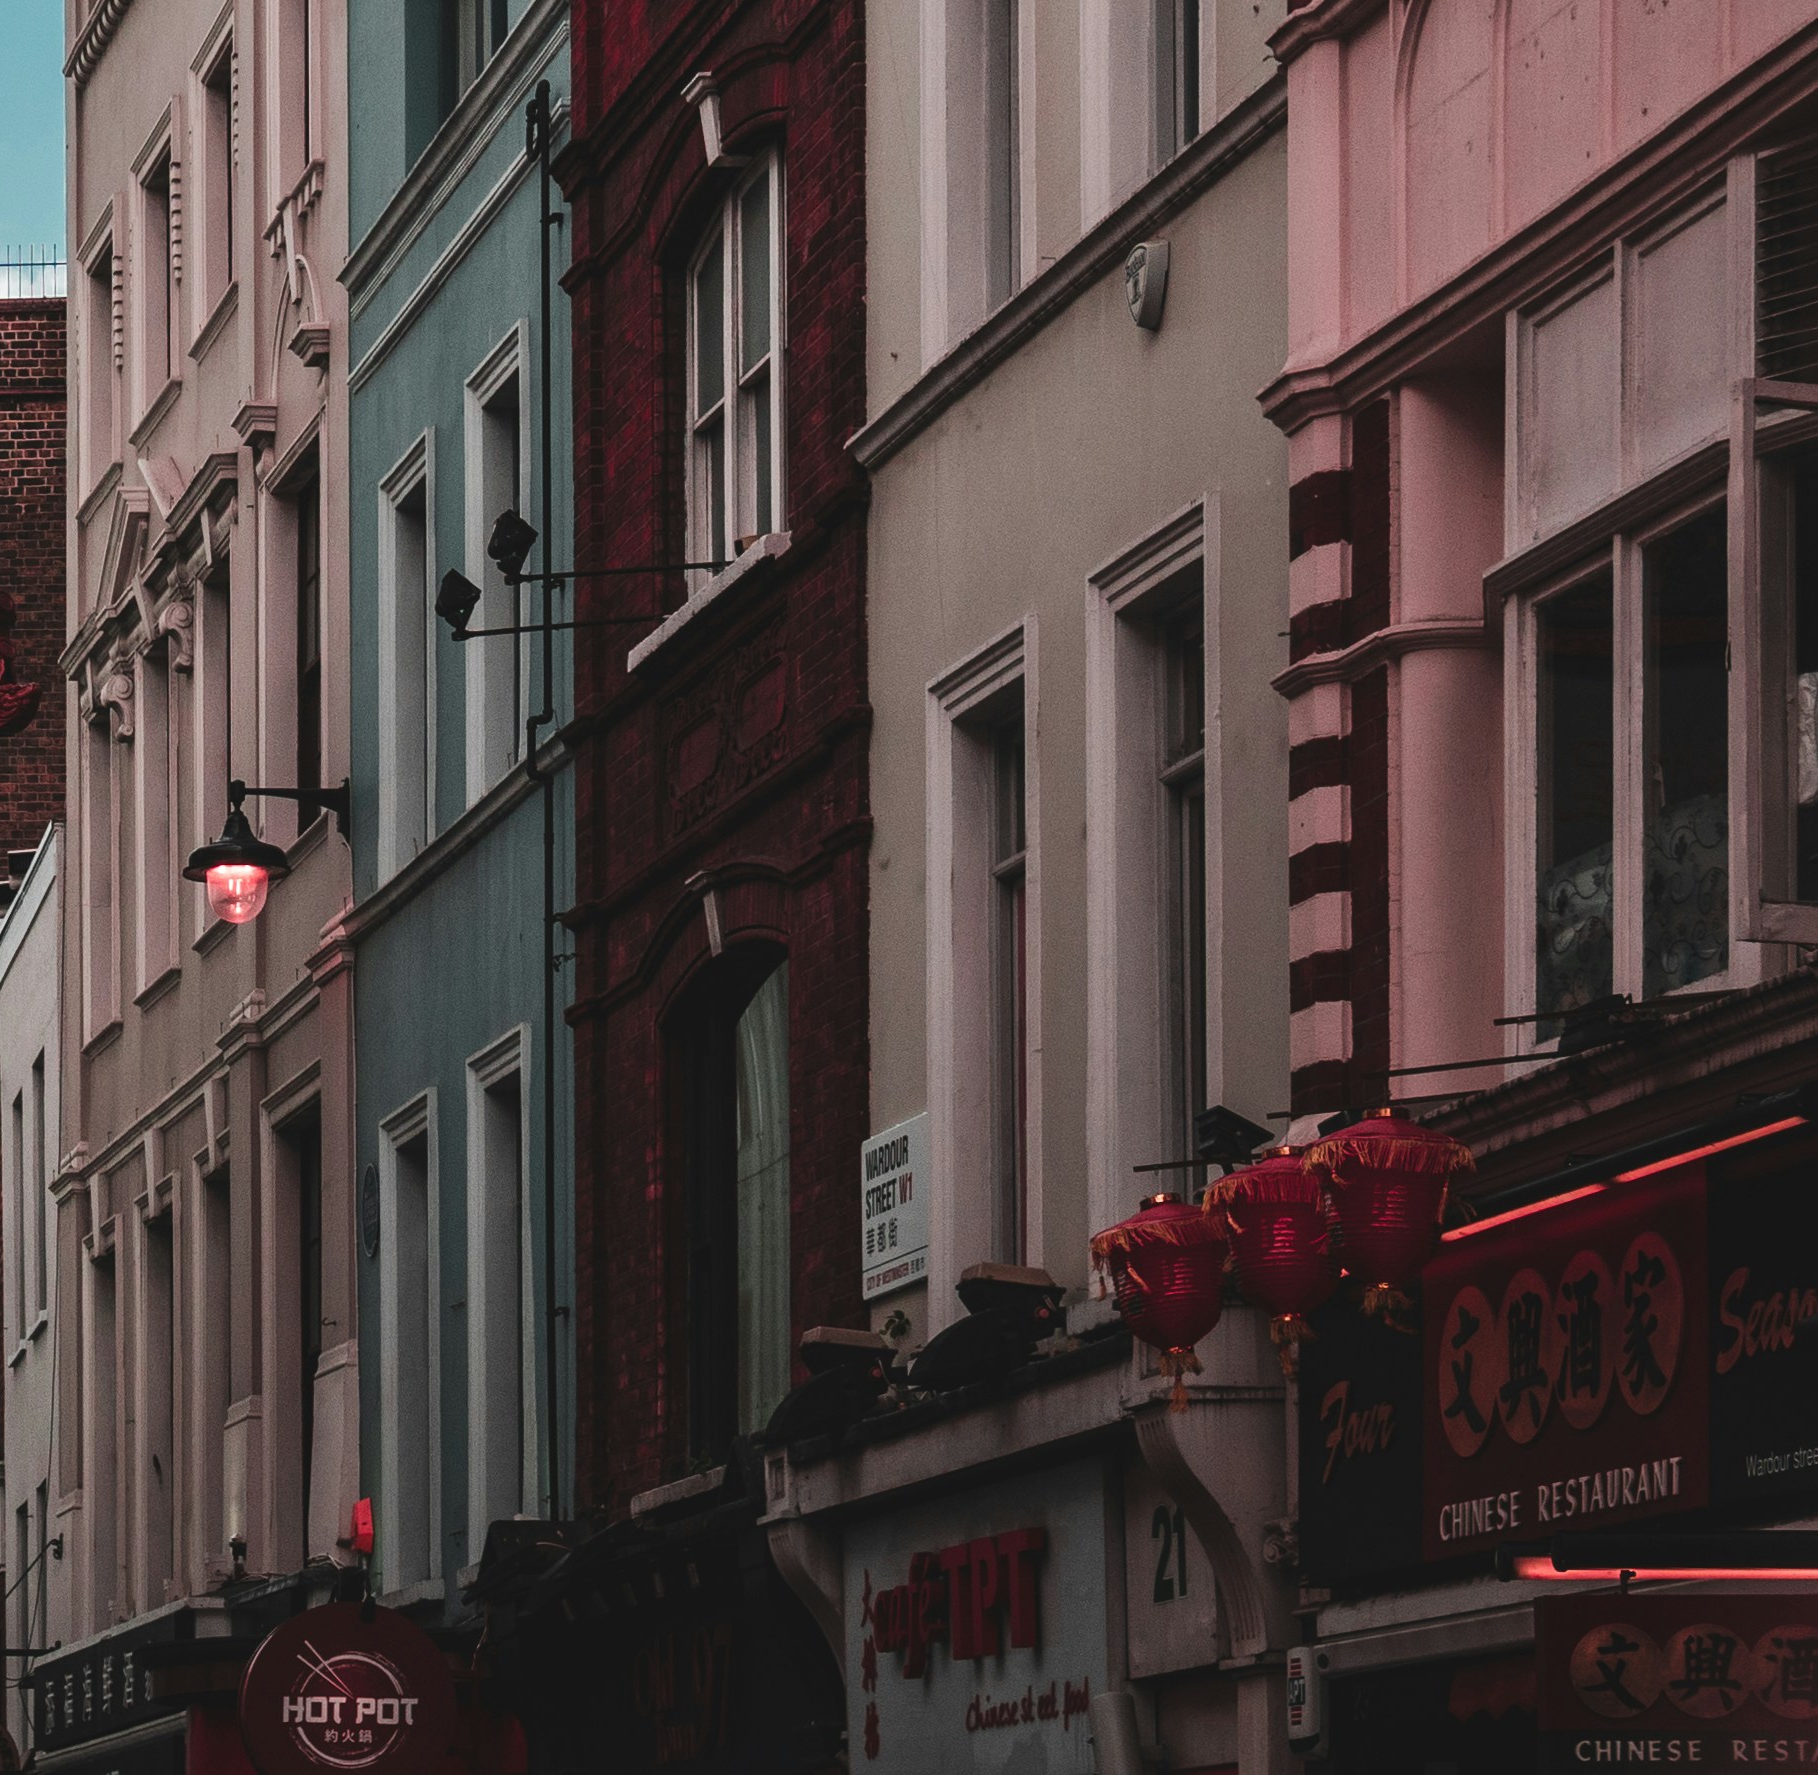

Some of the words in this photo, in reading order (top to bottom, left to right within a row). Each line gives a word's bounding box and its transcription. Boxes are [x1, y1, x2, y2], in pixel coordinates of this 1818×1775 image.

[865, 1135, 909, 1181] WARDOUR
[865, 1178, 896, 1219] STREET
[899, 1172, 913, 1205] W1
[1444, 1251, 1668, 1433] 文興酒家
[1318, 1378, 1397, 1487] Four
[1746, 1451, 1791, 1479] Wardour
[1438, 1489, 1523, 1543] CHINESE
[1537, 1455, 1685, 1524] RESTAURANT
[1151, 1504, 1188, 1604] 21
[940, 1527, 1047, 1660] TPT
[281, 1696, 348, 1725] HOT
[354, 1697, 419, 1726] POT
[1063, 1676, 1089, 1731] food
[1574, 1740, 1702, 1762] CHINESE
[1732, 1740, 1818, 1762] REST
